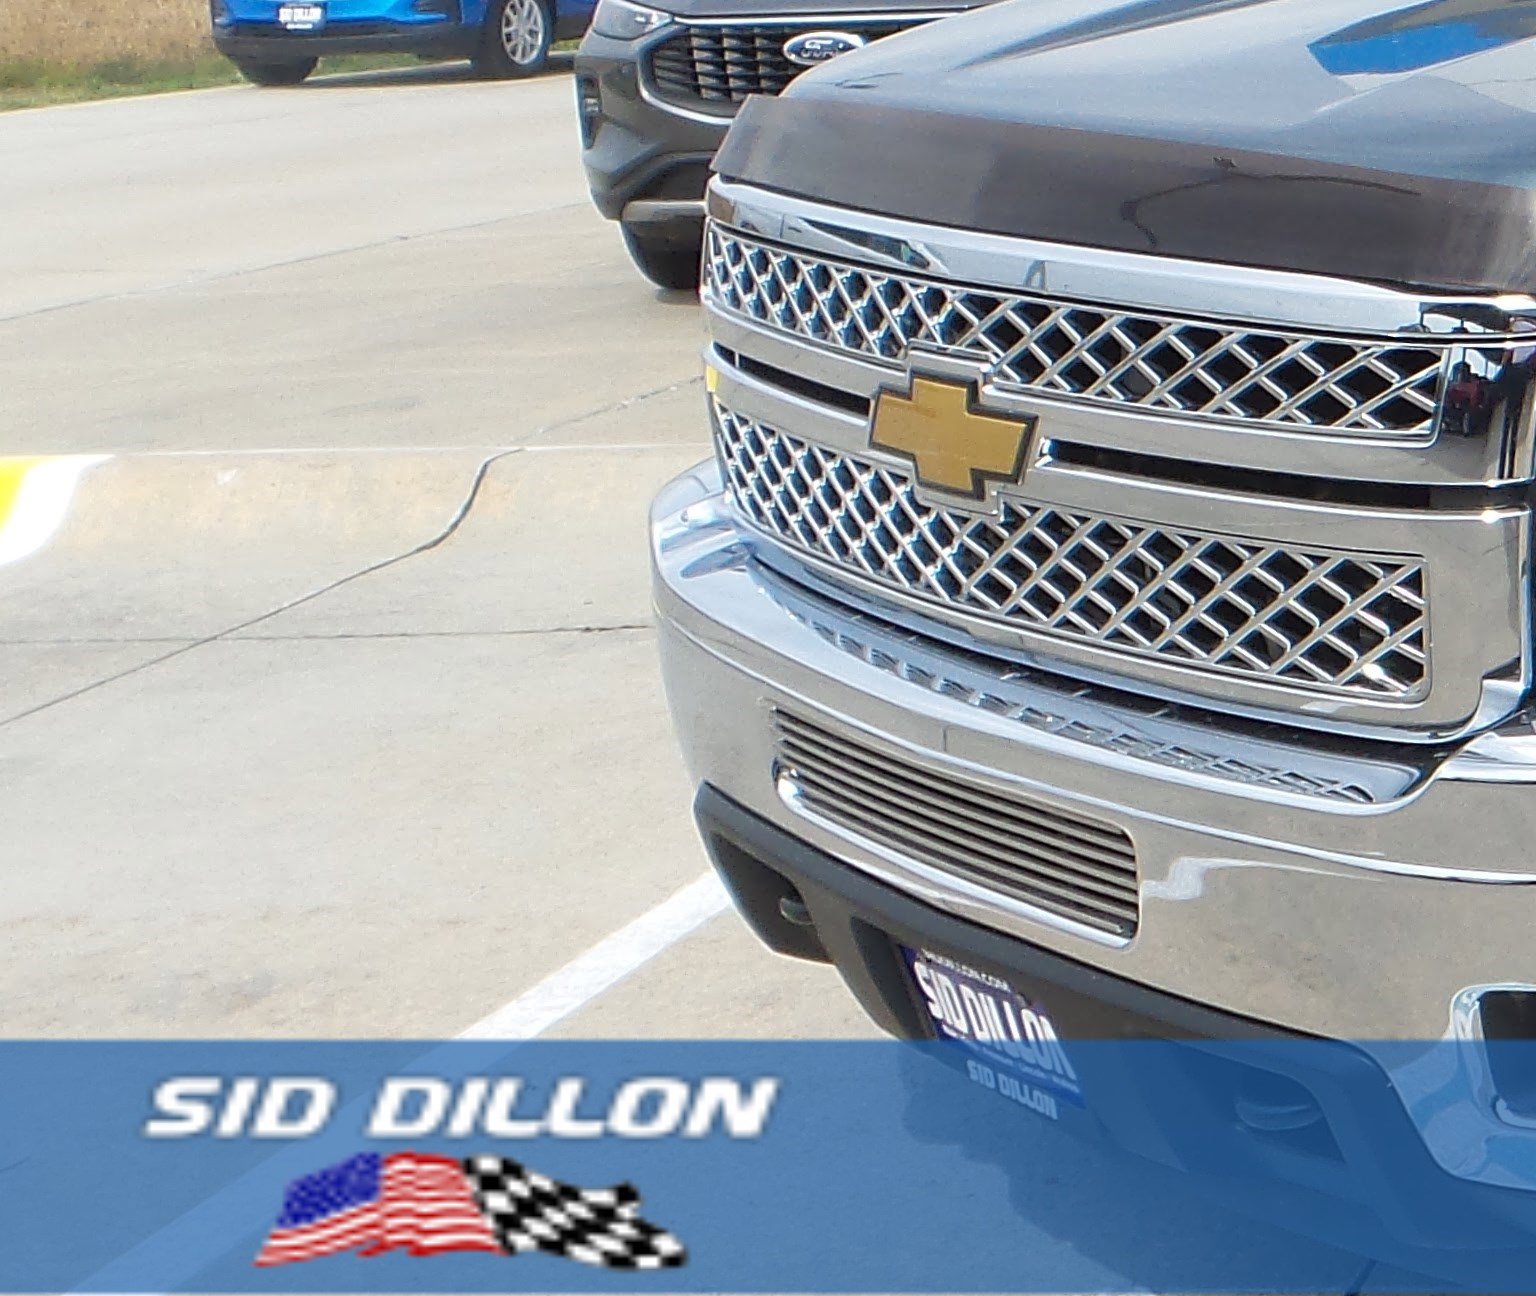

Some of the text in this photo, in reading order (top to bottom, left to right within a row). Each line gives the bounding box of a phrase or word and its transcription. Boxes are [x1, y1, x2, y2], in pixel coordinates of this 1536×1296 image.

[914, 961, 1078, 1081] SID DILLON
[966, 1059, 996, 1089] SID
[998, 1073, 1059, 1120] DILLON
